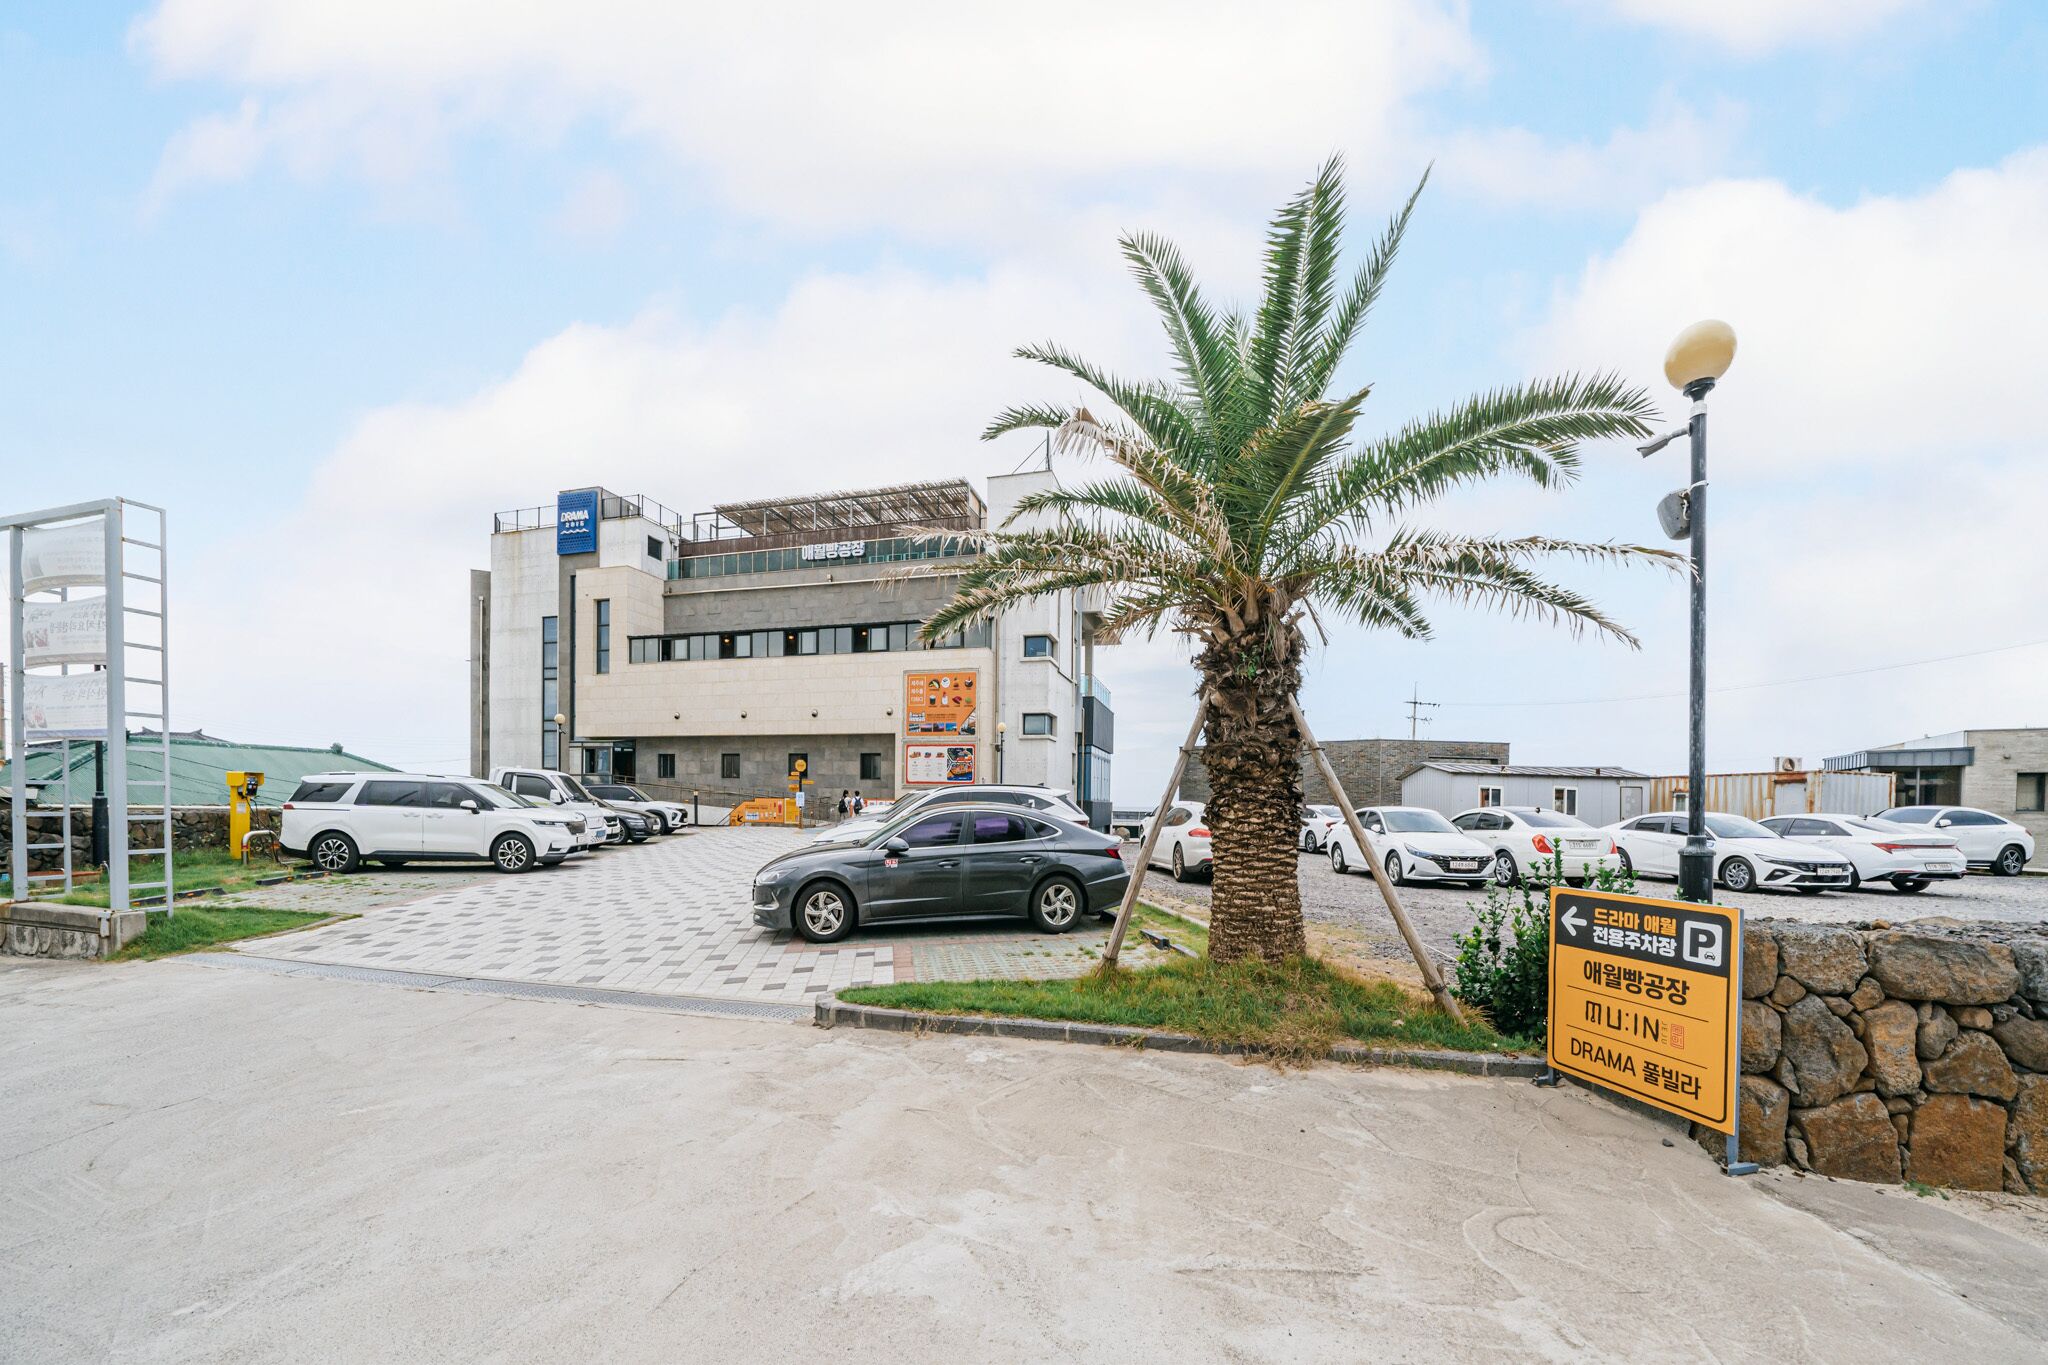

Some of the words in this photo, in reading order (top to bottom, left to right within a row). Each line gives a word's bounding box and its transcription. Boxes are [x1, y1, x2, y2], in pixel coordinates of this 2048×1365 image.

[560, 509, 589, 522] DRAMA
[801, 540, 865, 561] 애월빵공장
[1593, 907, 1639, 931] 드라마
[1643, 914, 1677, 937] 애월
[1592, 925, 1678, 958] 전용주차장
[1583, 960, 1690, 1006] 애월빵공장
[1570, 1037, 1637, 1077] DRAMA
[1642, 1060, 1702, 1100] 풀빌라
